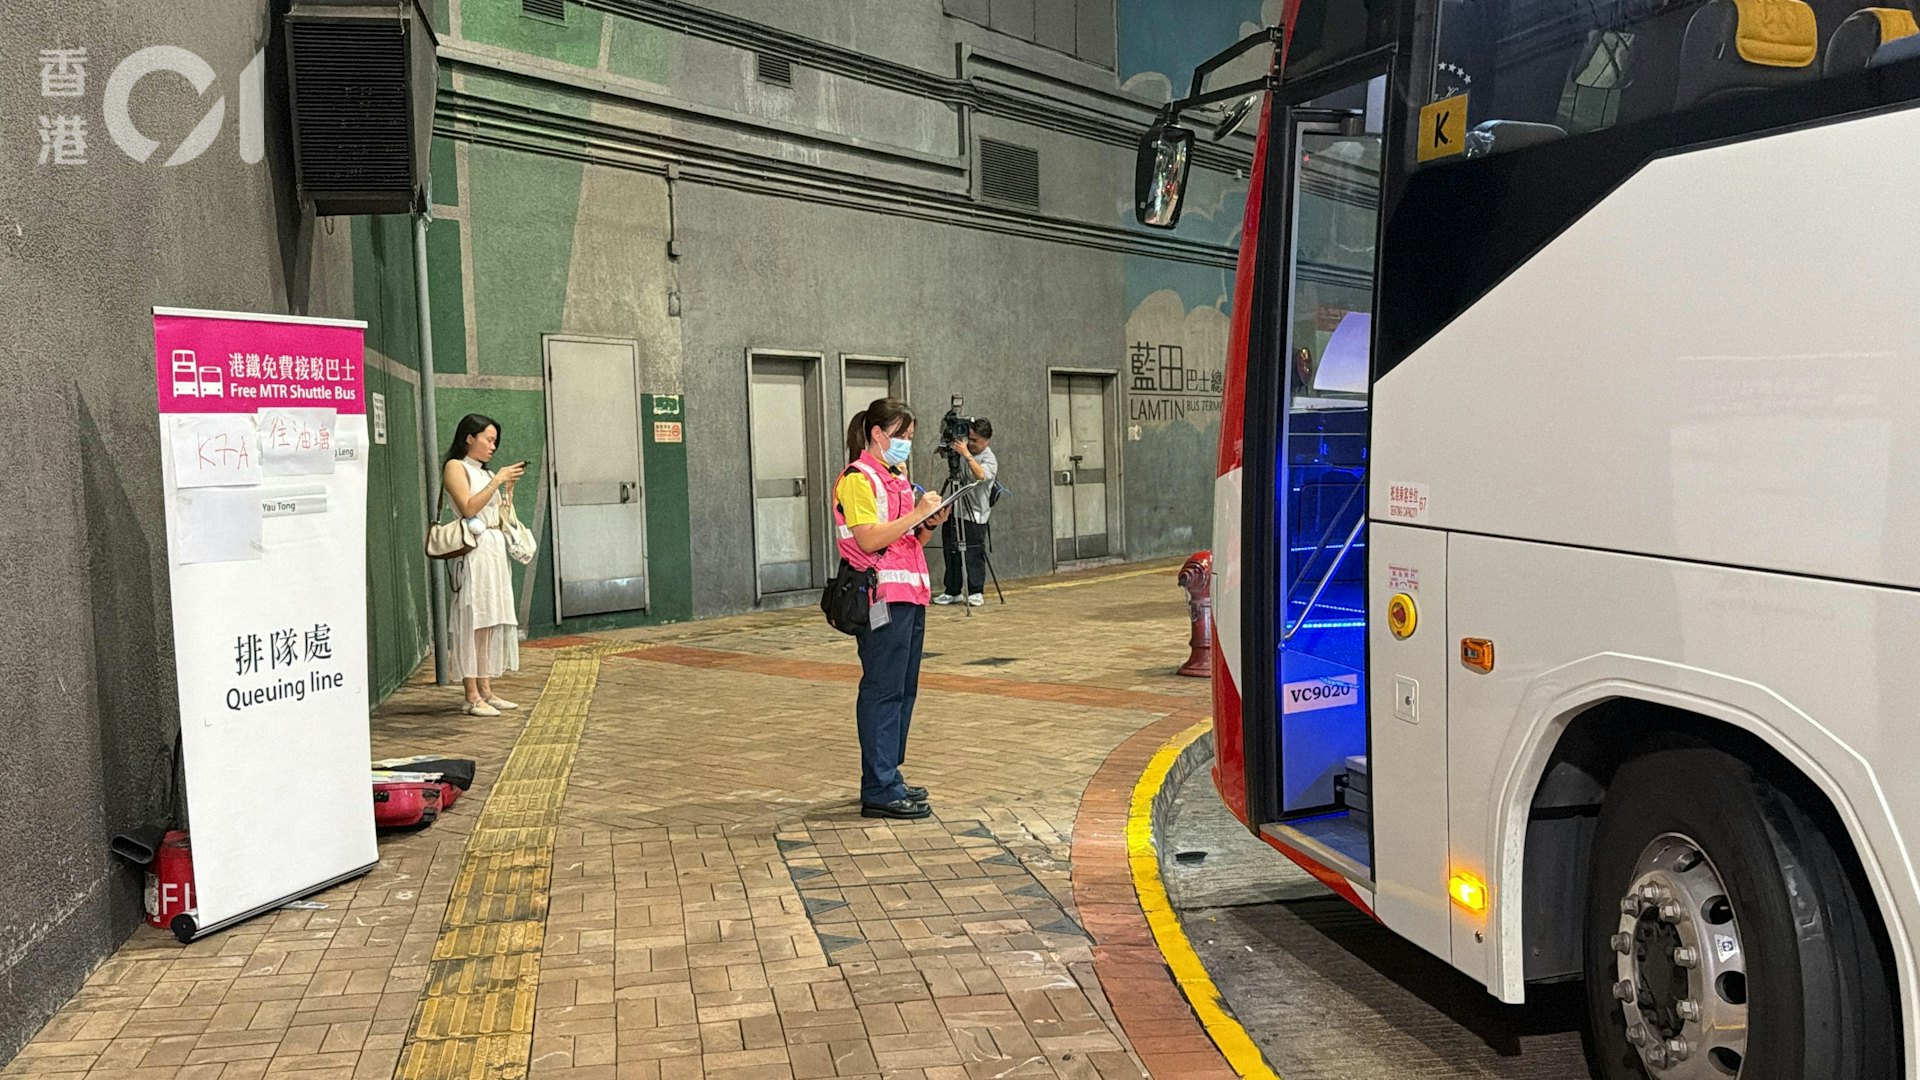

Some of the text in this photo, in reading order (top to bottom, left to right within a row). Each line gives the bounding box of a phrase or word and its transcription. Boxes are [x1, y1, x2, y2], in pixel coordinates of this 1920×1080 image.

[228, 352, 356, 381] 港鐵免費接駁巴士
[1129, 341, 1183, 392] 藍田
[230, 383, 356, 400] Free MTR Shuttle Bus
[1130, 399, 1185, 420] LAMTIN
[1187, 400, 1200, 411] BUS
[197, 432, 249, 470] K7A
[339, 448, 354, 458] Leng
[262, 502, 296, 512] Yau Tong
[1419, 497, 1427, 511] 67
[234, 623, 332, 676] 排隊處
[226, 671, 343, 711] Queuing line
[1291, 684, 1350, 703] VC9020
